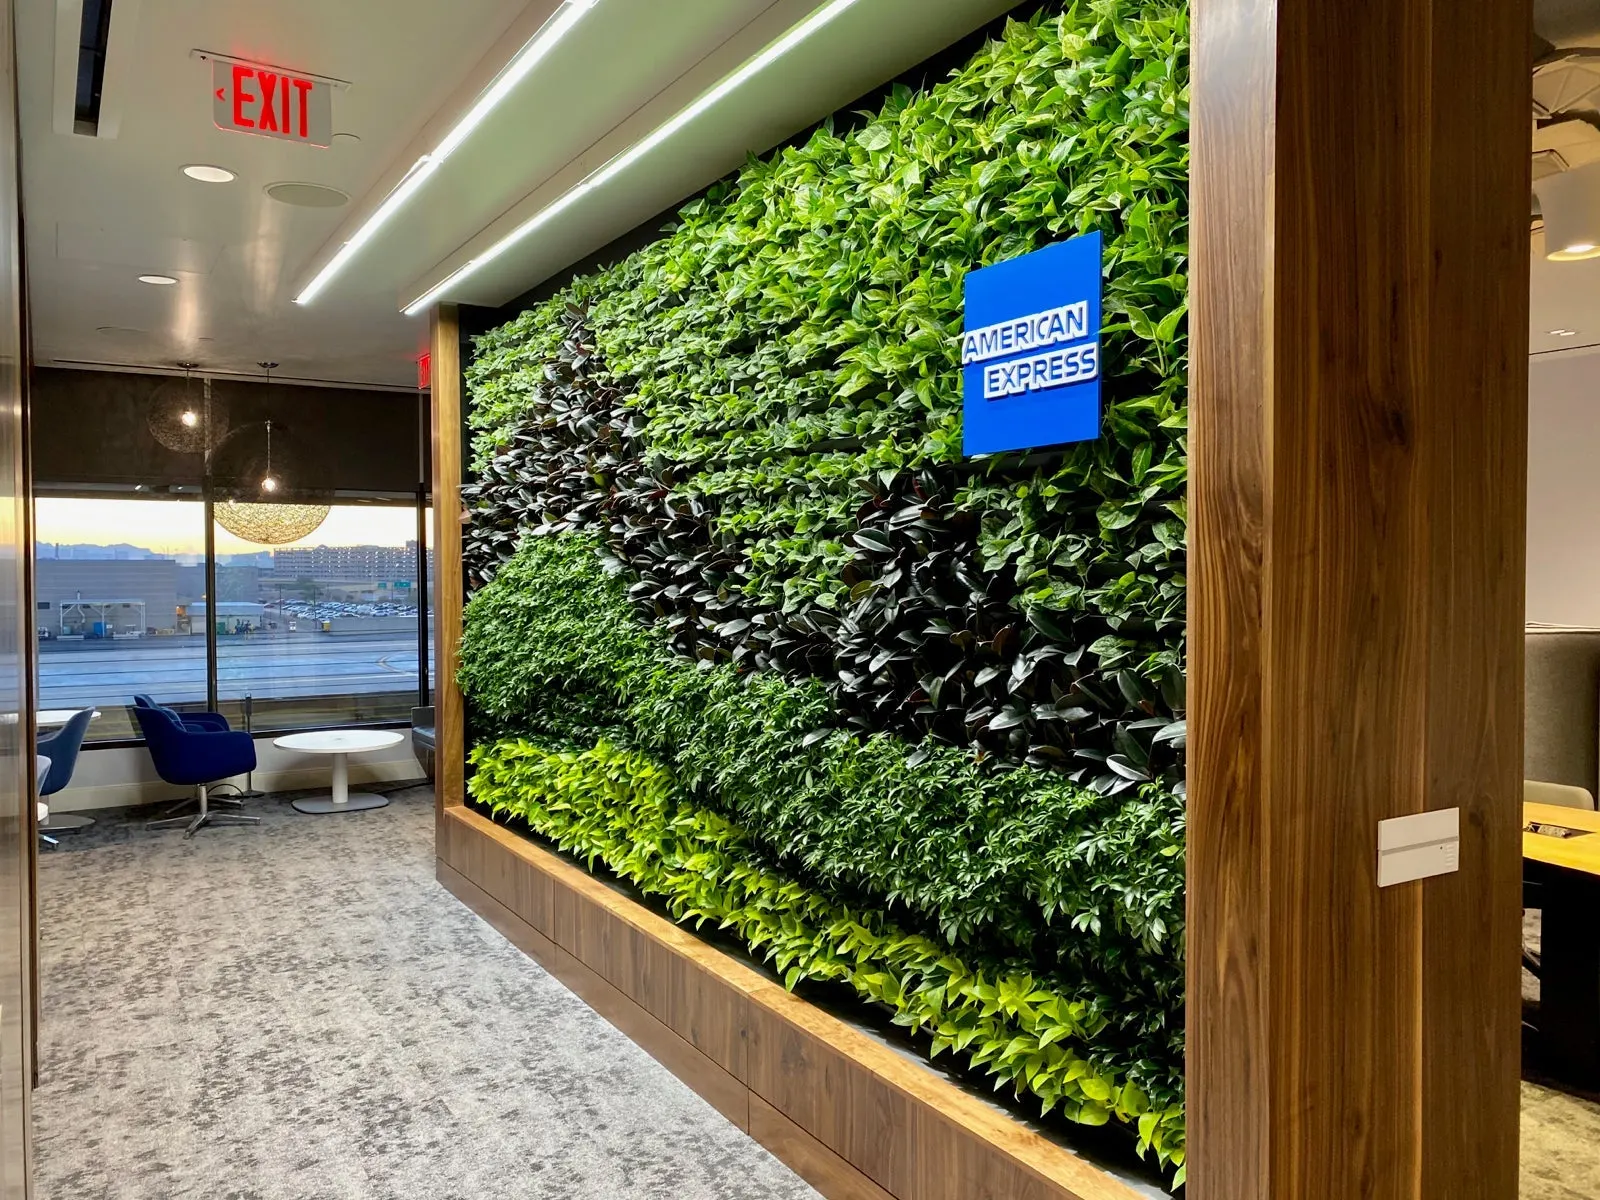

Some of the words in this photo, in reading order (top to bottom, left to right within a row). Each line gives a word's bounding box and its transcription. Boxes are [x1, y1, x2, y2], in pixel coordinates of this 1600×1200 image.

[232, 64, 313, 138] EXIT
[963, 303, 1086, 360] AMERICAN
[986, 346, 1097, 395] EXPRESS
